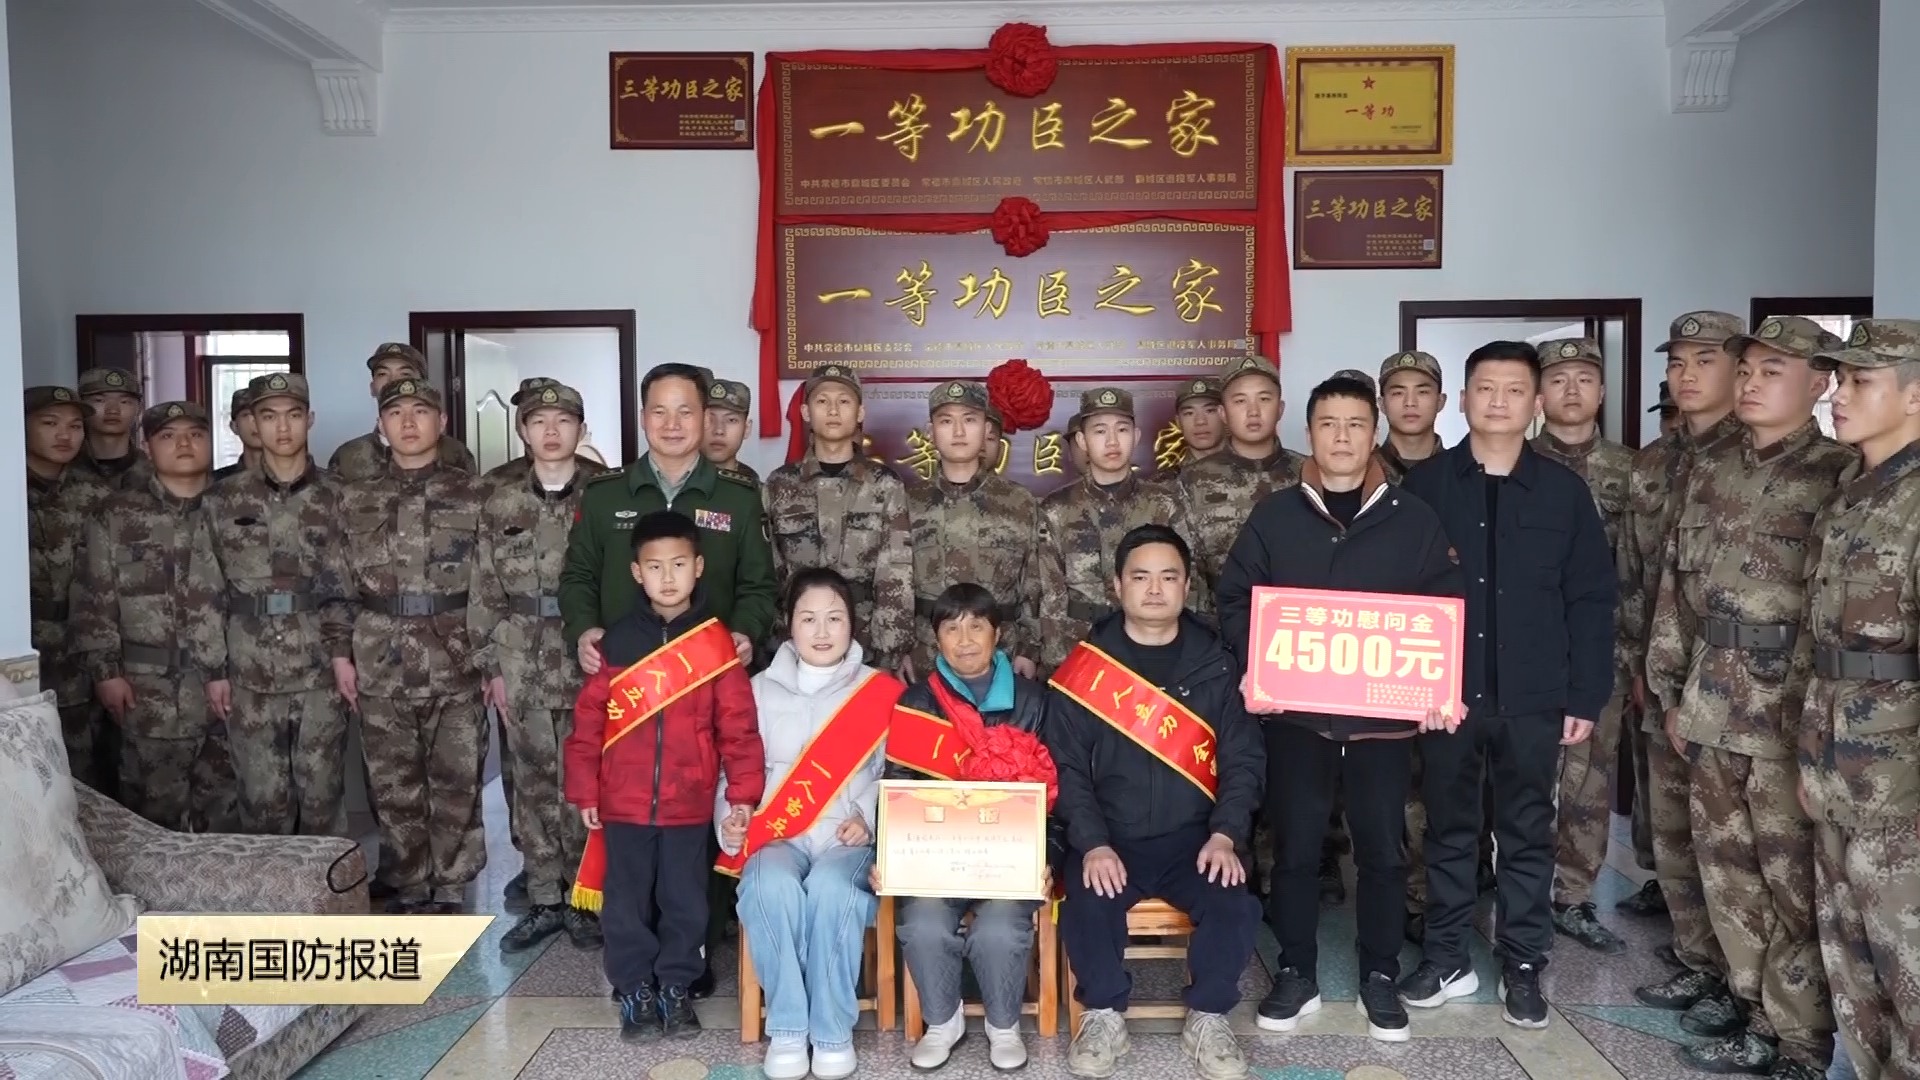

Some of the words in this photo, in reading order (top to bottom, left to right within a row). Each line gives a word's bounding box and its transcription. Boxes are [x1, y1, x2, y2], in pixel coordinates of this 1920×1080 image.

[620, 76, 743, 102] 三等功臣之家
[1345, 103, 1395, 121] 一等功
[809, 90, 1219, 162] 一等功臣之家
[1306, 195, 1433, 222] 三等功臣之家
[818, 258, 1223, 327] 一等功臣之家
[1279, 606, 1434, 633] 三等功慰问金
[1265, 628, 1444, 680] 4500元
[606, 653, 693, 720] 一人立功
[1090, 669, 1178, 739] 一人立功
[766, 760, 831, 837] 一人当兵
